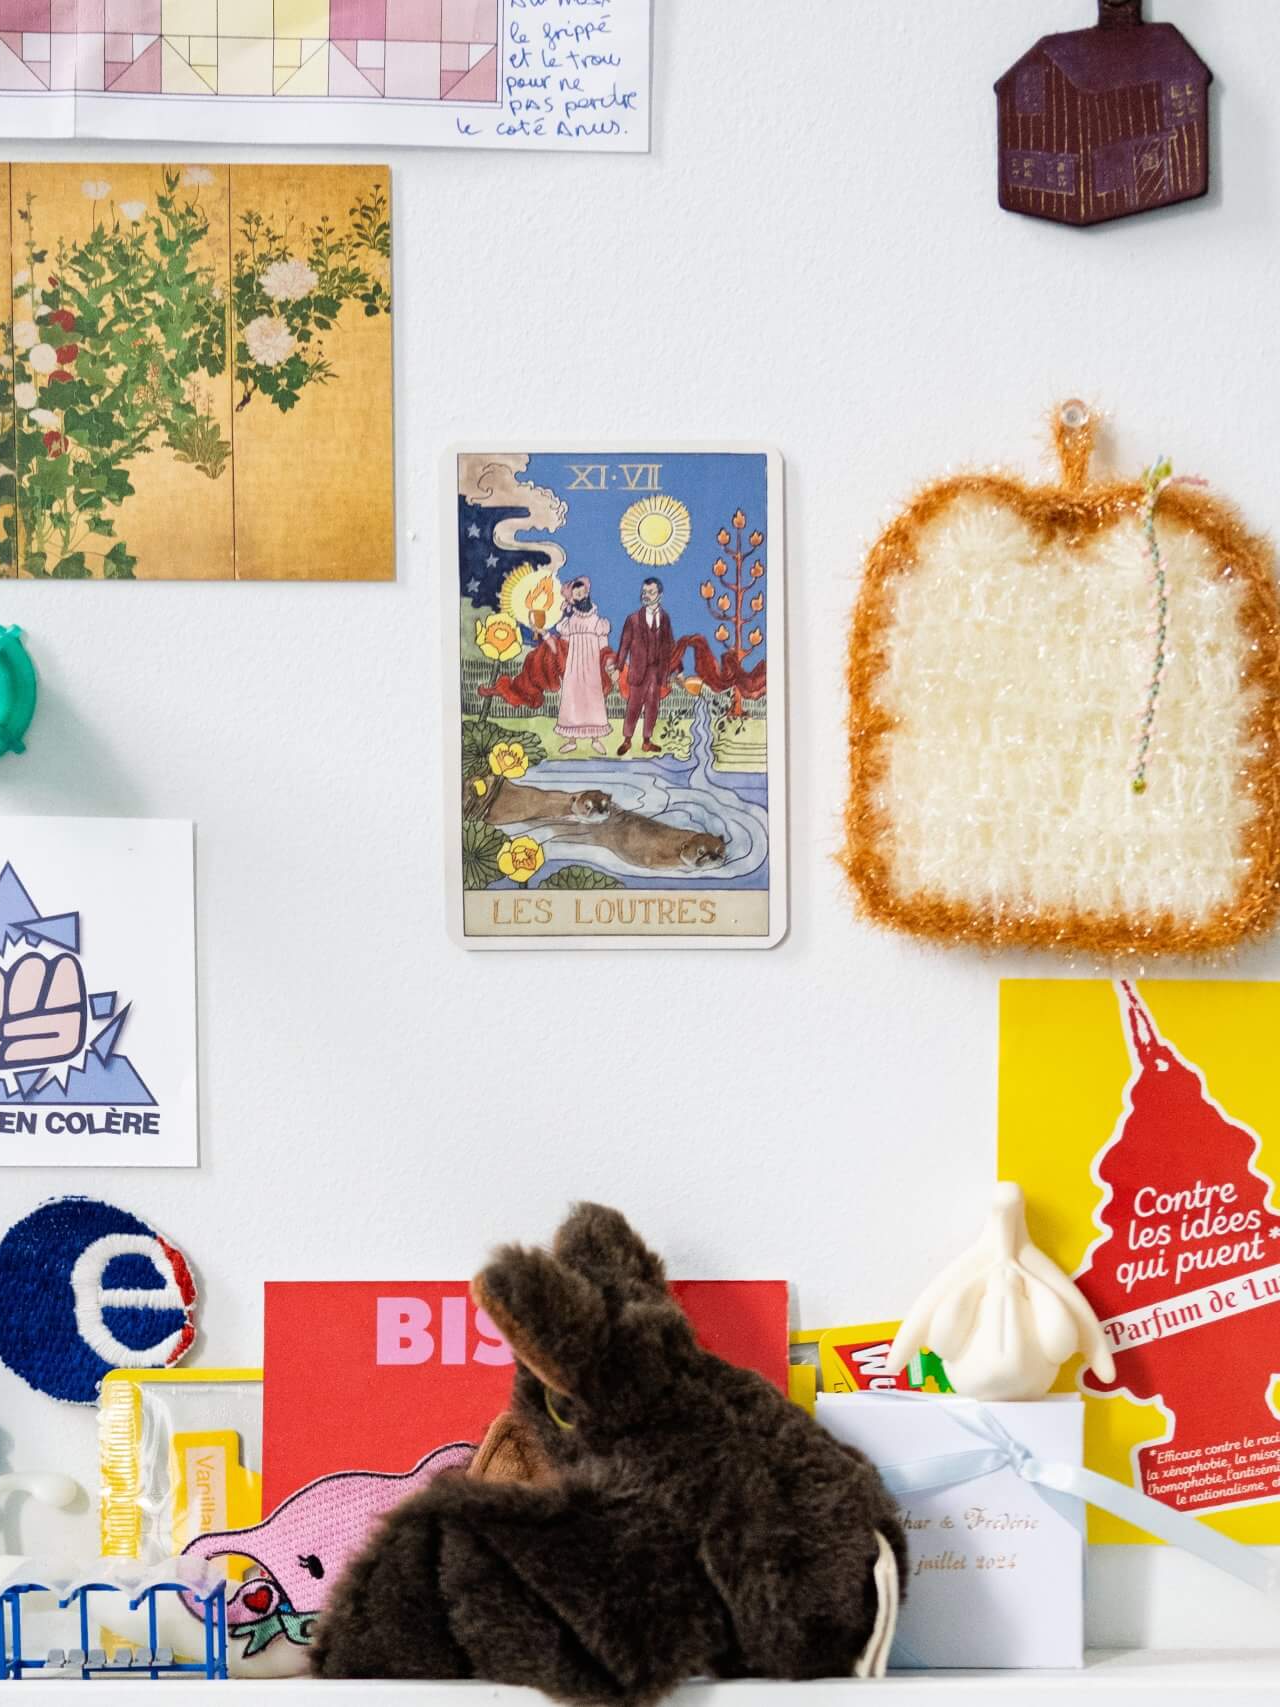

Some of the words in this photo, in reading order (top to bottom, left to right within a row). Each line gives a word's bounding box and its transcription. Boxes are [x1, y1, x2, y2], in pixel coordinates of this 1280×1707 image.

[510, 21, 531, 44] le
[509, 48, 533, 69] et
[541, 49, 563, 68] le
[566, 51, 622, 71] trou
[506, 75, 551, 96] pour
[559, 76, 584, 92] ne
[456, 117, 482, 136] le
[492, 898, 553, 925] LES
[573, 898, 718, 925] LOUTRES
[44, 1106, 161, 1135] COLÈRE
[1133, 1179, 1239, 1218] Contre
[1127, 1219, 1172, 1251] les
[1179, 1206, 1263, 1242] idées
[1115, 1248, 1170, 1295] qui
[1103, 1302, 1203, 1347] Parfum
[1205, 1289, 1240, 1314] de
[1204, 1440, 1242, 1456] contre
[1243, 1436, 1256, 1449] le
[1146, 1469, 1159, 1481] la
[1162, 1457, 1232, 1479] xénophobie,
[1234, 1452, 1248, 1465] la
[1175, 1493, 1187, 1506] le
[1189, 1481, 1269, 1503] nationalisme,
[912, 1550, 967, 1577] juillet
